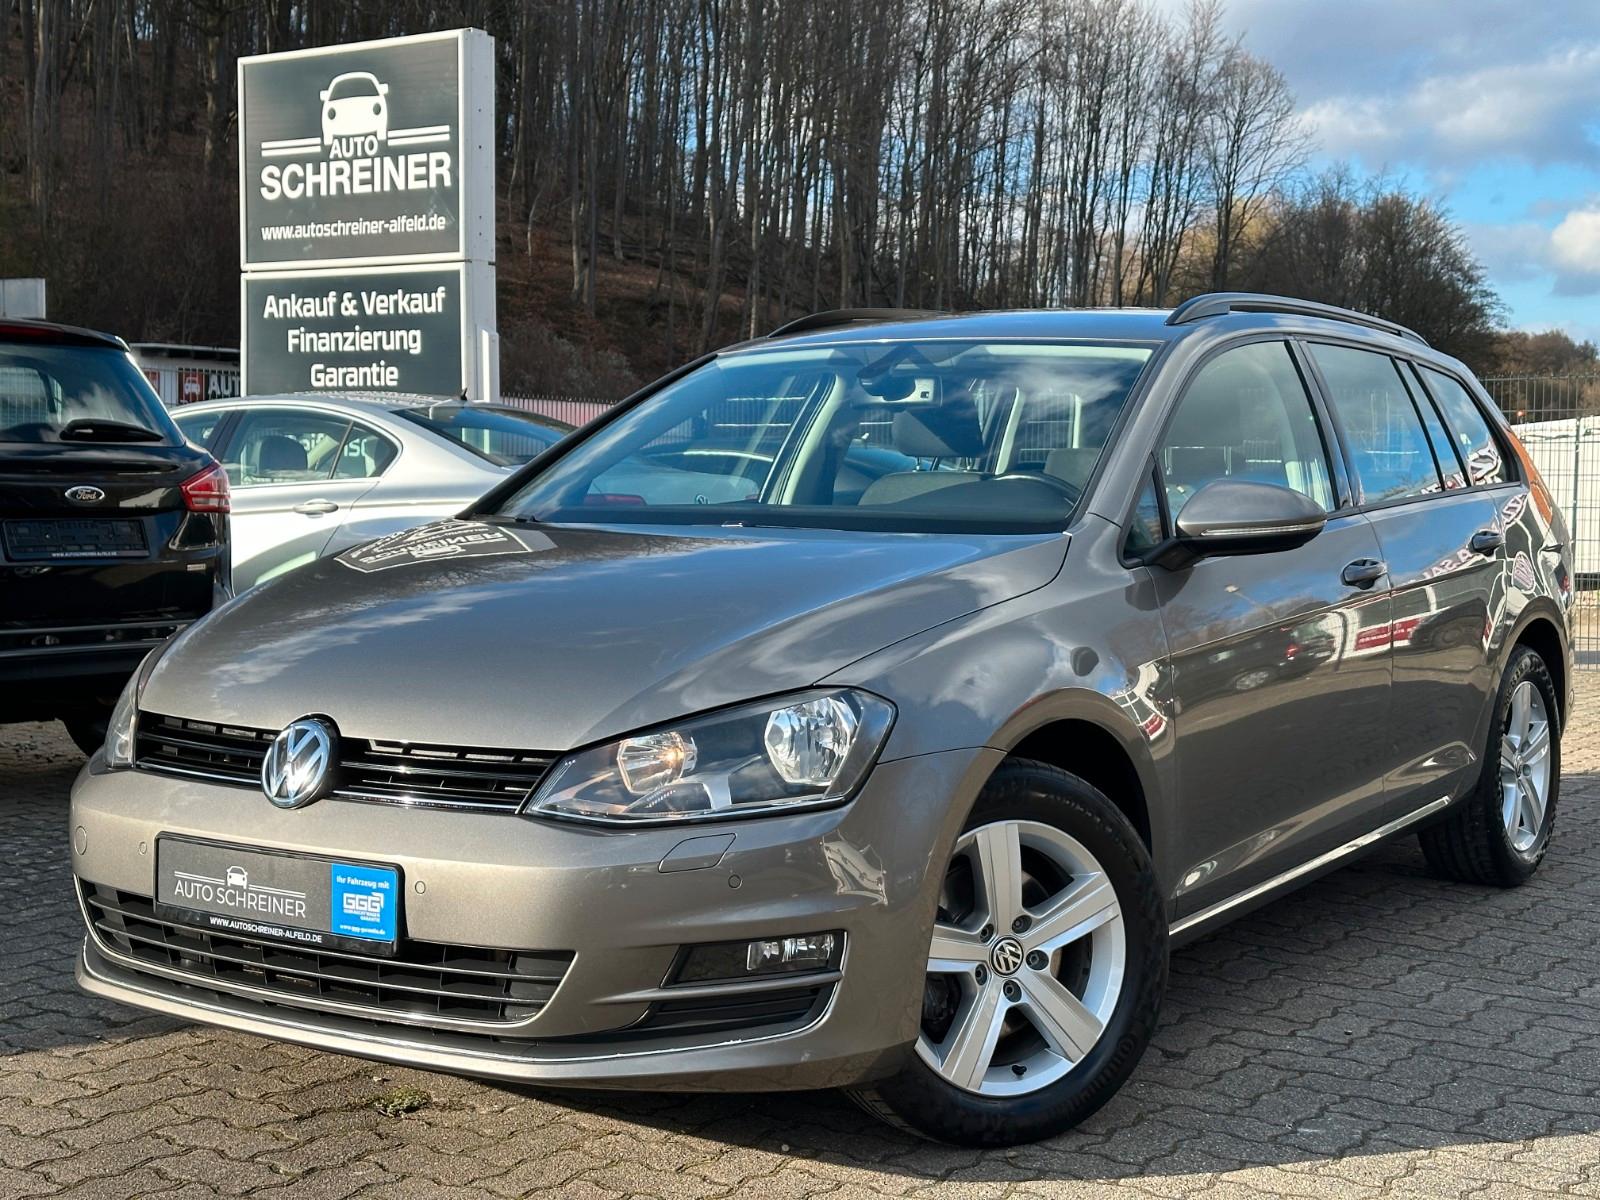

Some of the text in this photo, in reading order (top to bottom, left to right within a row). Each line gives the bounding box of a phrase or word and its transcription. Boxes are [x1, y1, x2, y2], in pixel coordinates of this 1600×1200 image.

[329, 135, 378, 159] AUTO
[260, 151, 451, 200] SCHREINER
[261, 214, 446, 240] www.autoschreiner-alfeld.de
[263, 286, 446, 318] Ankauf & Verkauf
[287, 325, 422, 354] Finanzierung
[310, 360, 399, 388] Garantie
[76, 488, 97, 500] Ford
[336, 875, 390, 889] Ihr Fahrzeug mit
[174, 879, 306, 918] AUTO SCHREINER
[343, 892, 383, 911] GGG
[209, 916, 323, 943] WWW.AUTOSCHREINER-ALFELD.DE
